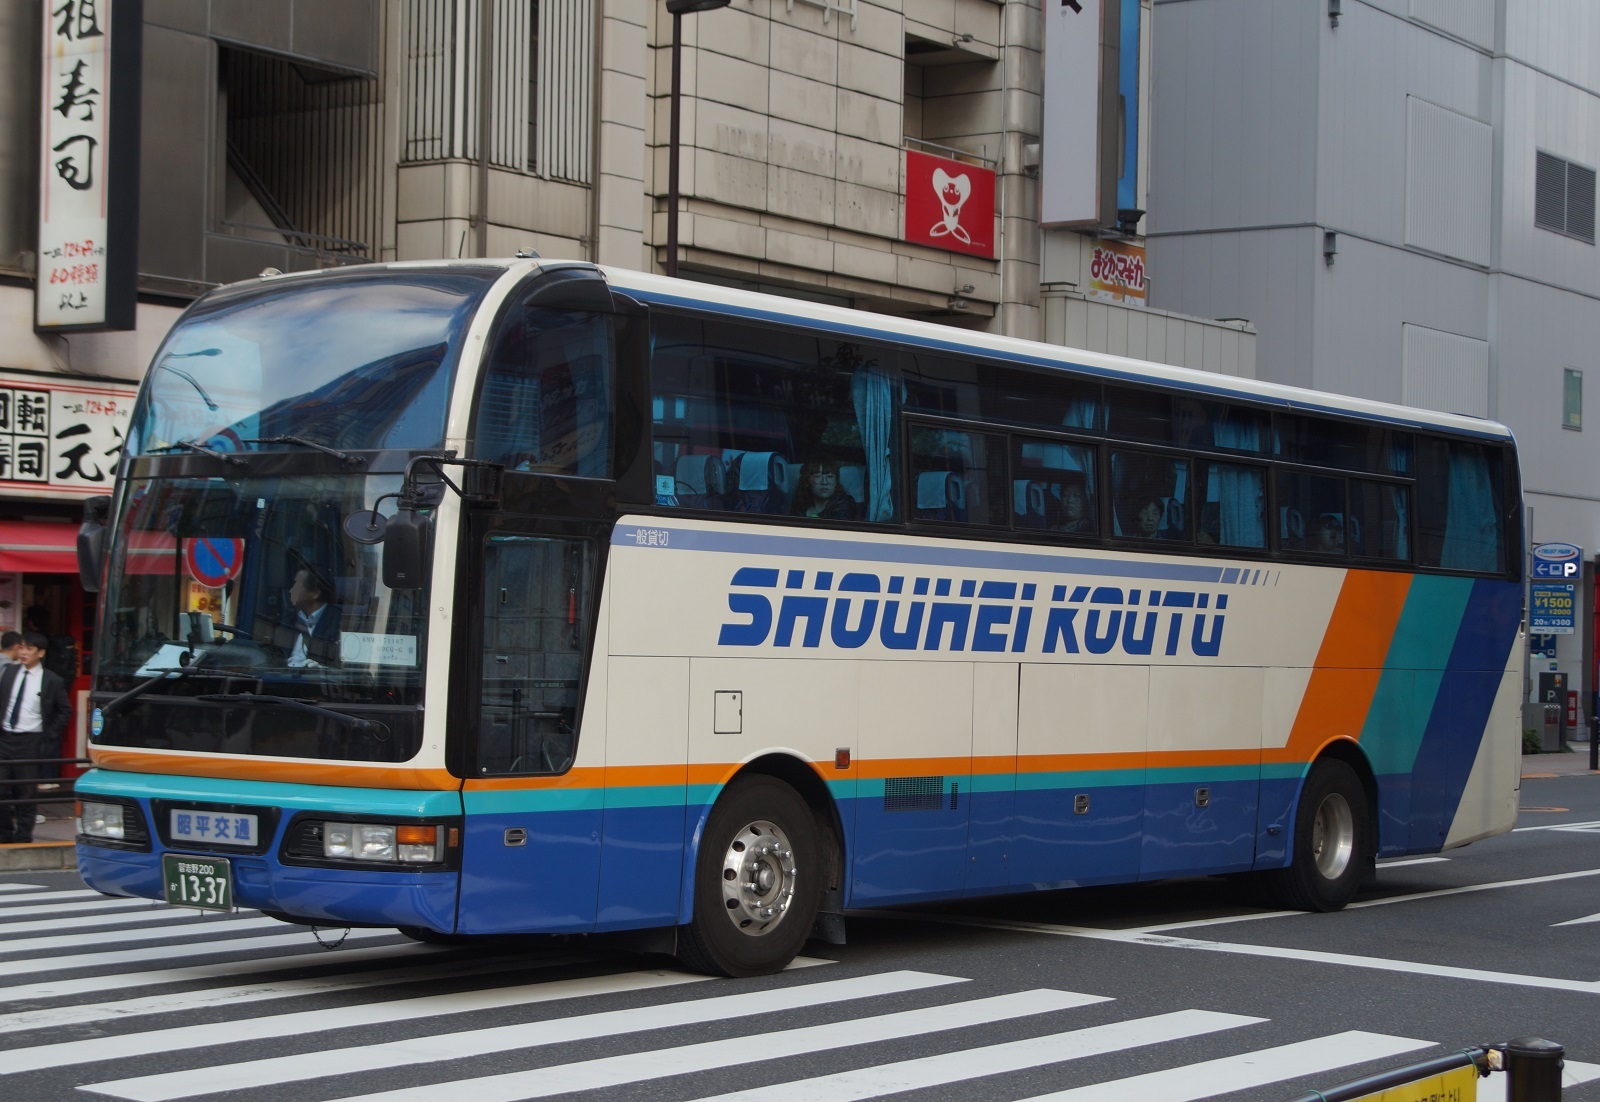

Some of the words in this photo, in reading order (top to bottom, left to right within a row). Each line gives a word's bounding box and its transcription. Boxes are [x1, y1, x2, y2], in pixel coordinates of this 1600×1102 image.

[59, 291, 88, 310] 以上
[625, 529, 669, 546] 一般貸切
[1564, 562, 1577, 577] P
[717, 566, 1037, 653] SHOUHEI
[1042, 585, 1228, 657] KOUTU
[1535, 597, 1572, 608] ¥1500
[177, 813, 250, 840] 昭平交通
[181, 874, 227, 905] 13-37
